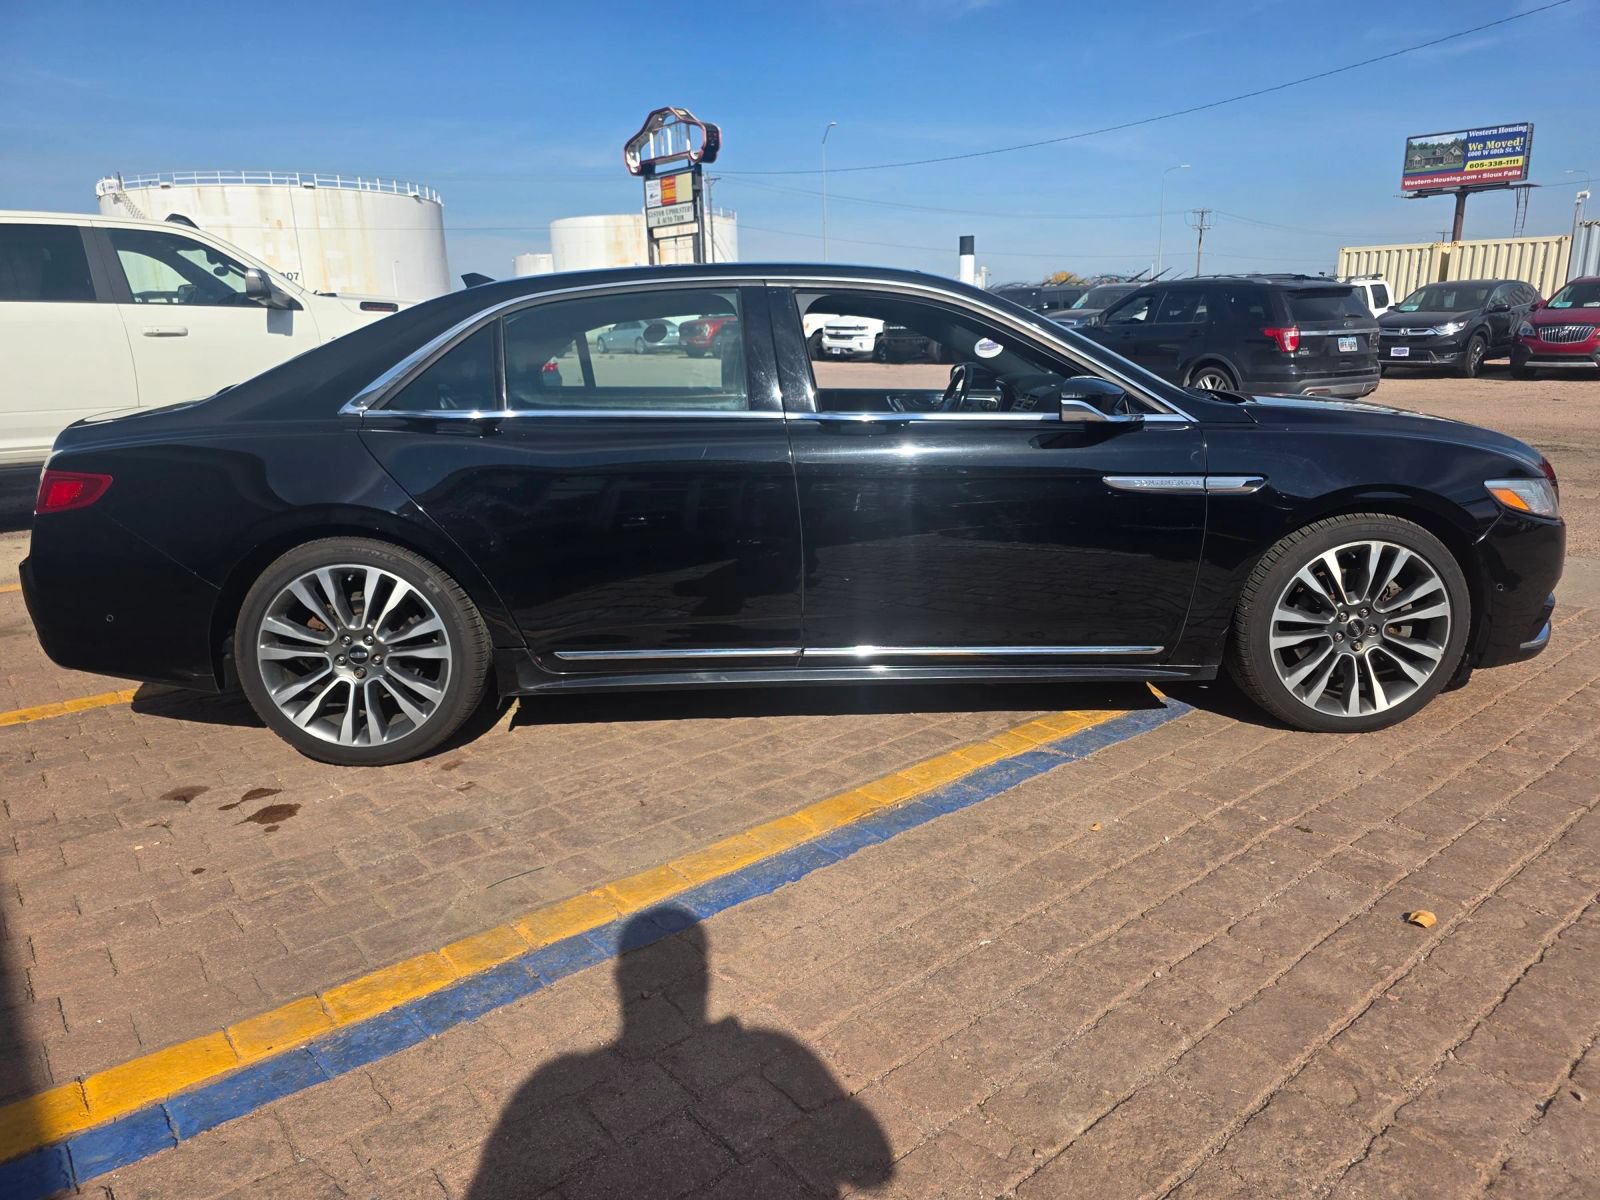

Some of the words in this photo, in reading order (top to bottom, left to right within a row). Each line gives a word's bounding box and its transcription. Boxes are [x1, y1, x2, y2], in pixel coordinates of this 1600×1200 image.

[1469, 129, 1497, 137] Western
[1498, 125, 1527, 134] Housing
[1468, 142, 1484, 151] We
[1486, 137, 1524, 149] Moved!
[1470, 159, 1519, 168] 605-338-1111
[1404, 174, 1477, 186] Western-Housing.com
